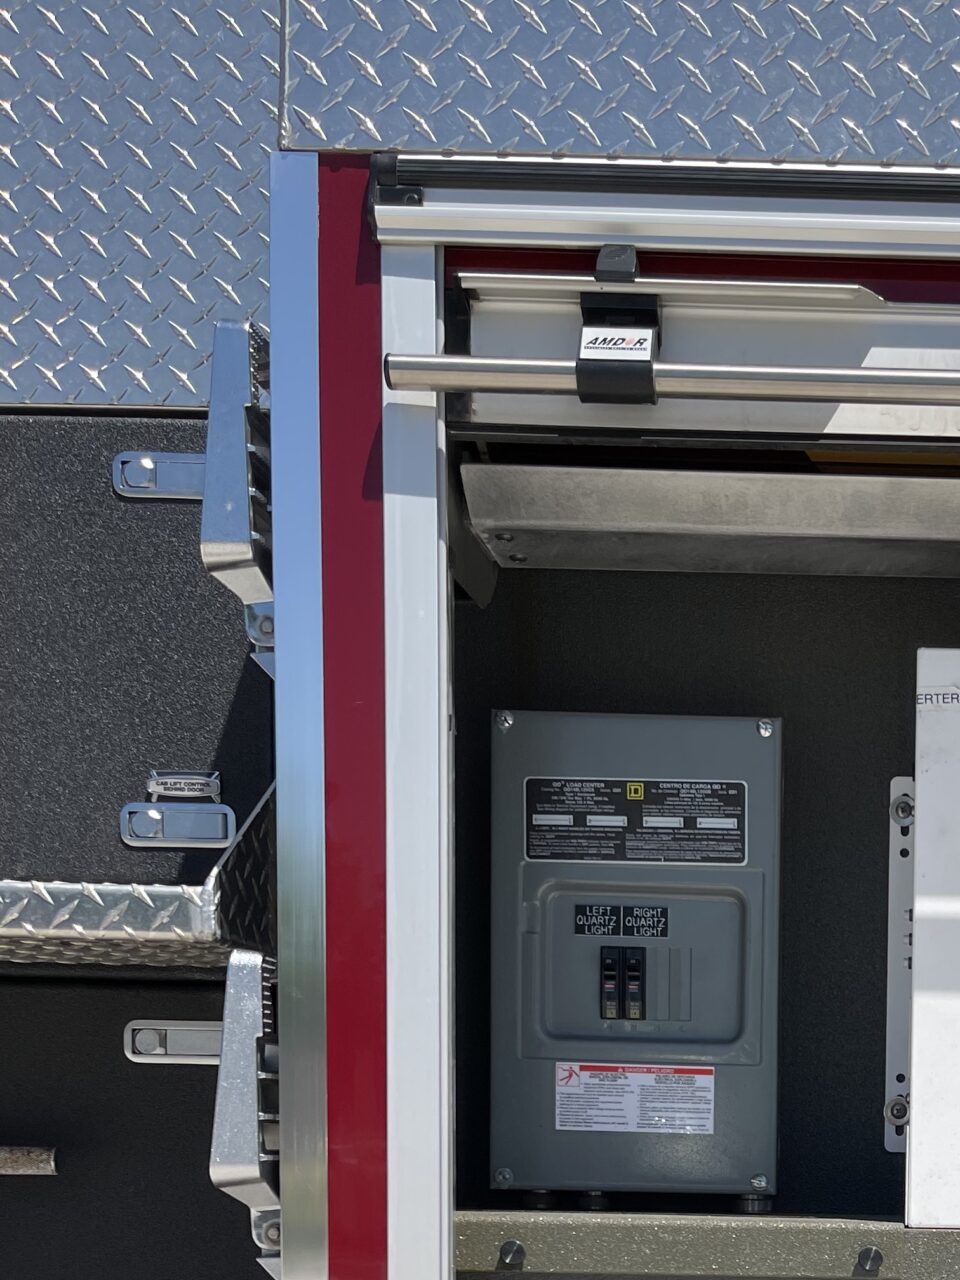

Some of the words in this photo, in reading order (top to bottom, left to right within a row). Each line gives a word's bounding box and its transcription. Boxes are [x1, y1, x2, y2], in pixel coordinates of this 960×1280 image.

[586, 906, 611, 916] LEFT
[633, 908, 662, 918] RIGHT
[576, 915, 617, 926] QUARTZ
[625, 917, 666, 928] QUARTZ
[585, 925, 614, 935] LIGHT
[633, 927, 662, 937] LIGHT
